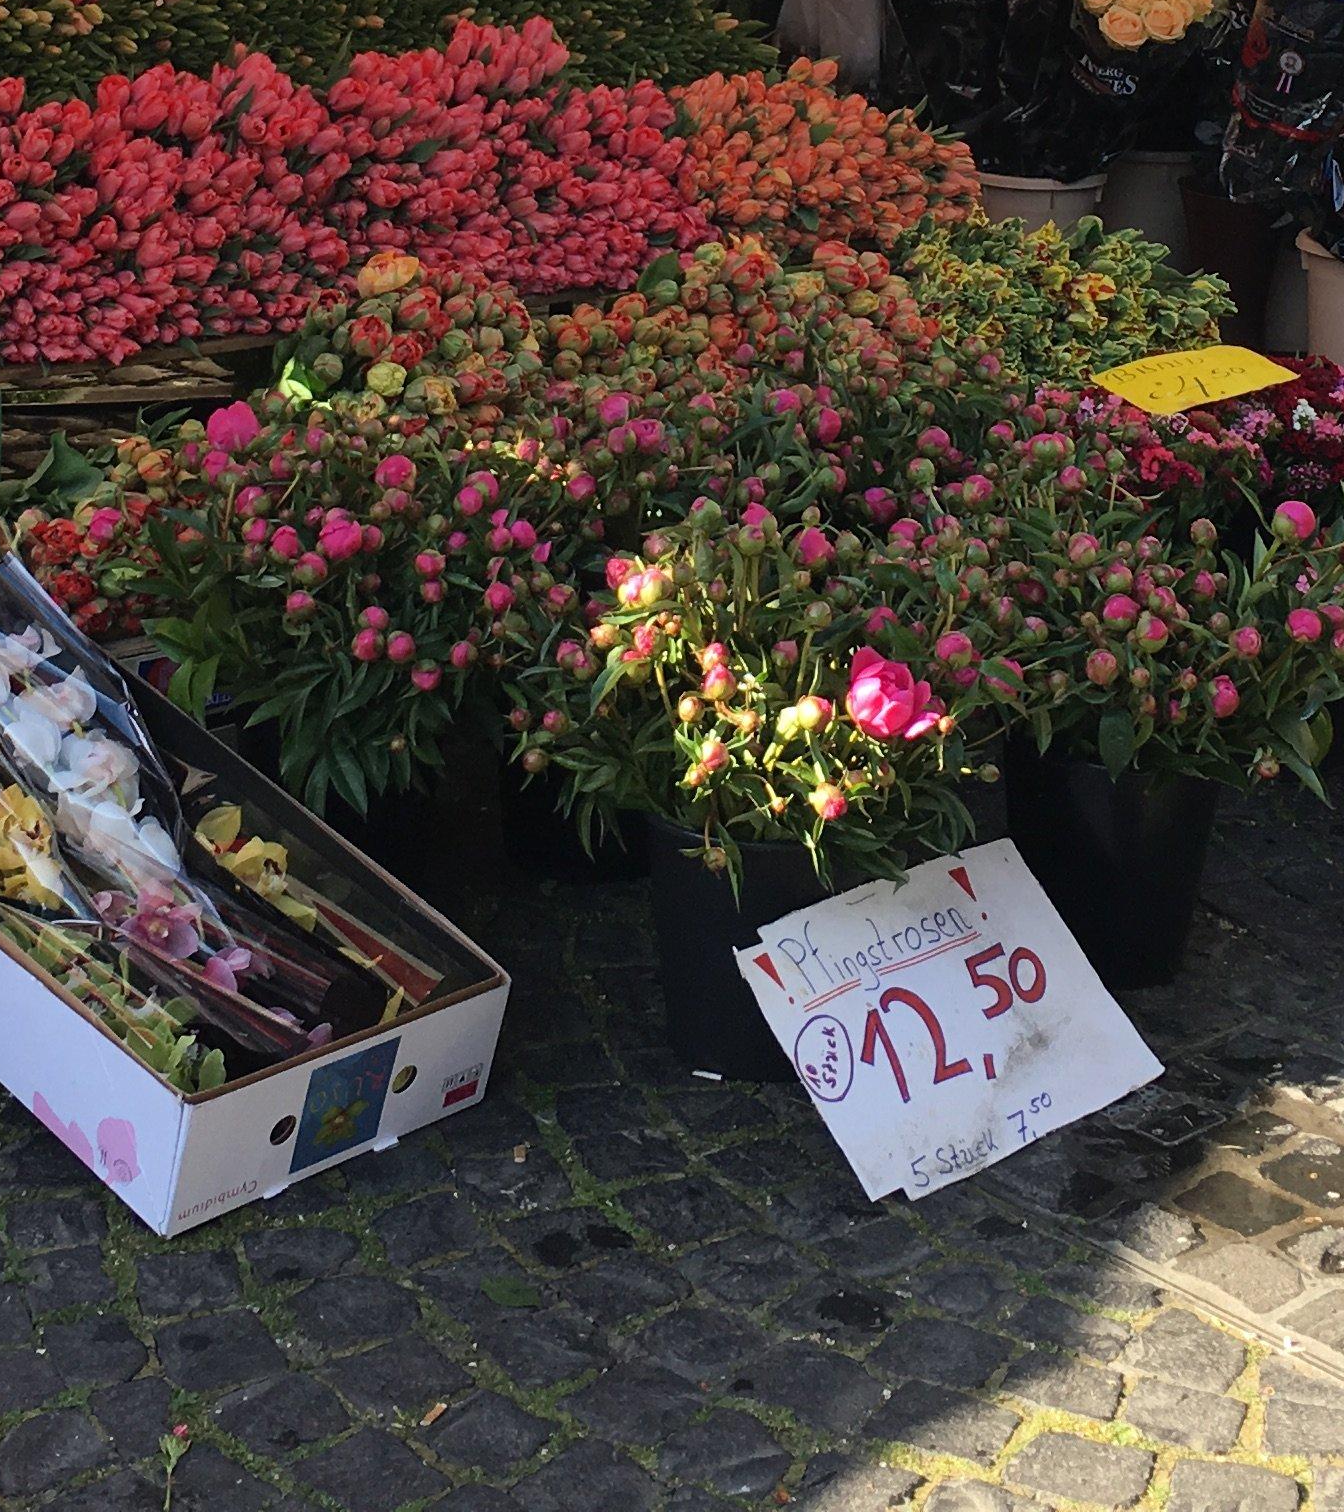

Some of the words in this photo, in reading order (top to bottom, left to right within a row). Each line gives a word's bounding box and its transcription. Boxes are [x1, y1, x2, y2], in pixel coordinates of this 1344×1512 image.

[910, 1155, 931, 1189] 5
[935, 1129, 999, 1176] Stück
[177, 1179, 258, 1222] Cymbidium
